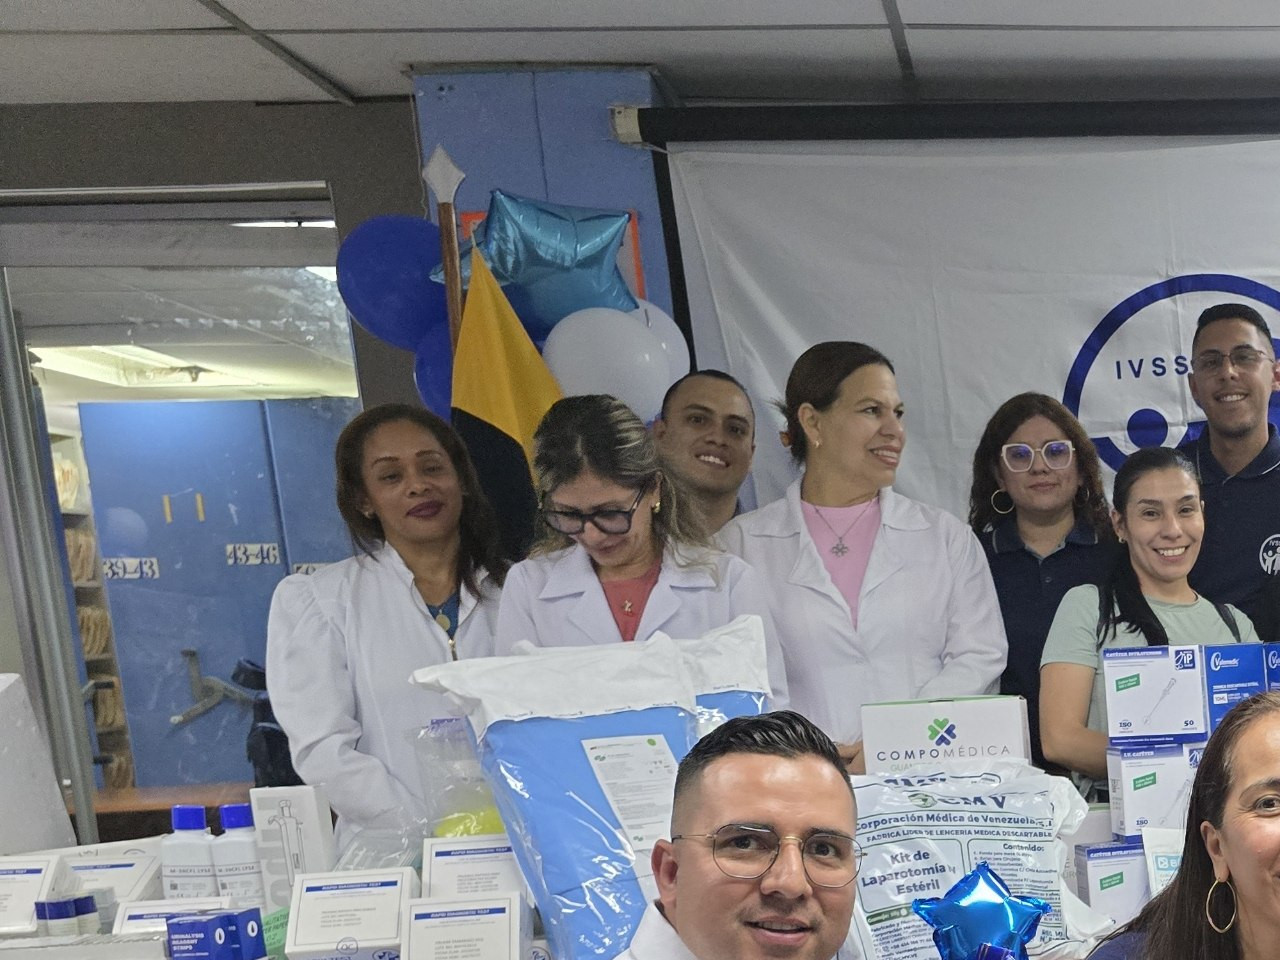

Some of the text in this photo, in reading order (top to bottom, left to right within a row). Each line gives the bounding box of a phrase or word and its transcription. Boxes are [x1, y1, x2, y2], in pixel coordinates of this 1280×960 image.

[1116, 355, 1189, 379] IVSS
[877, 745, 1010, 761] COMPOMÉDICA
[926, 813, 965, 822] Médica
[967, 814, 979, 823] de
[890, 850, 930, 864] Kit de
[861, 863, 946, 887] Laparotomía
[896, 879, 941, 895] Estéril
